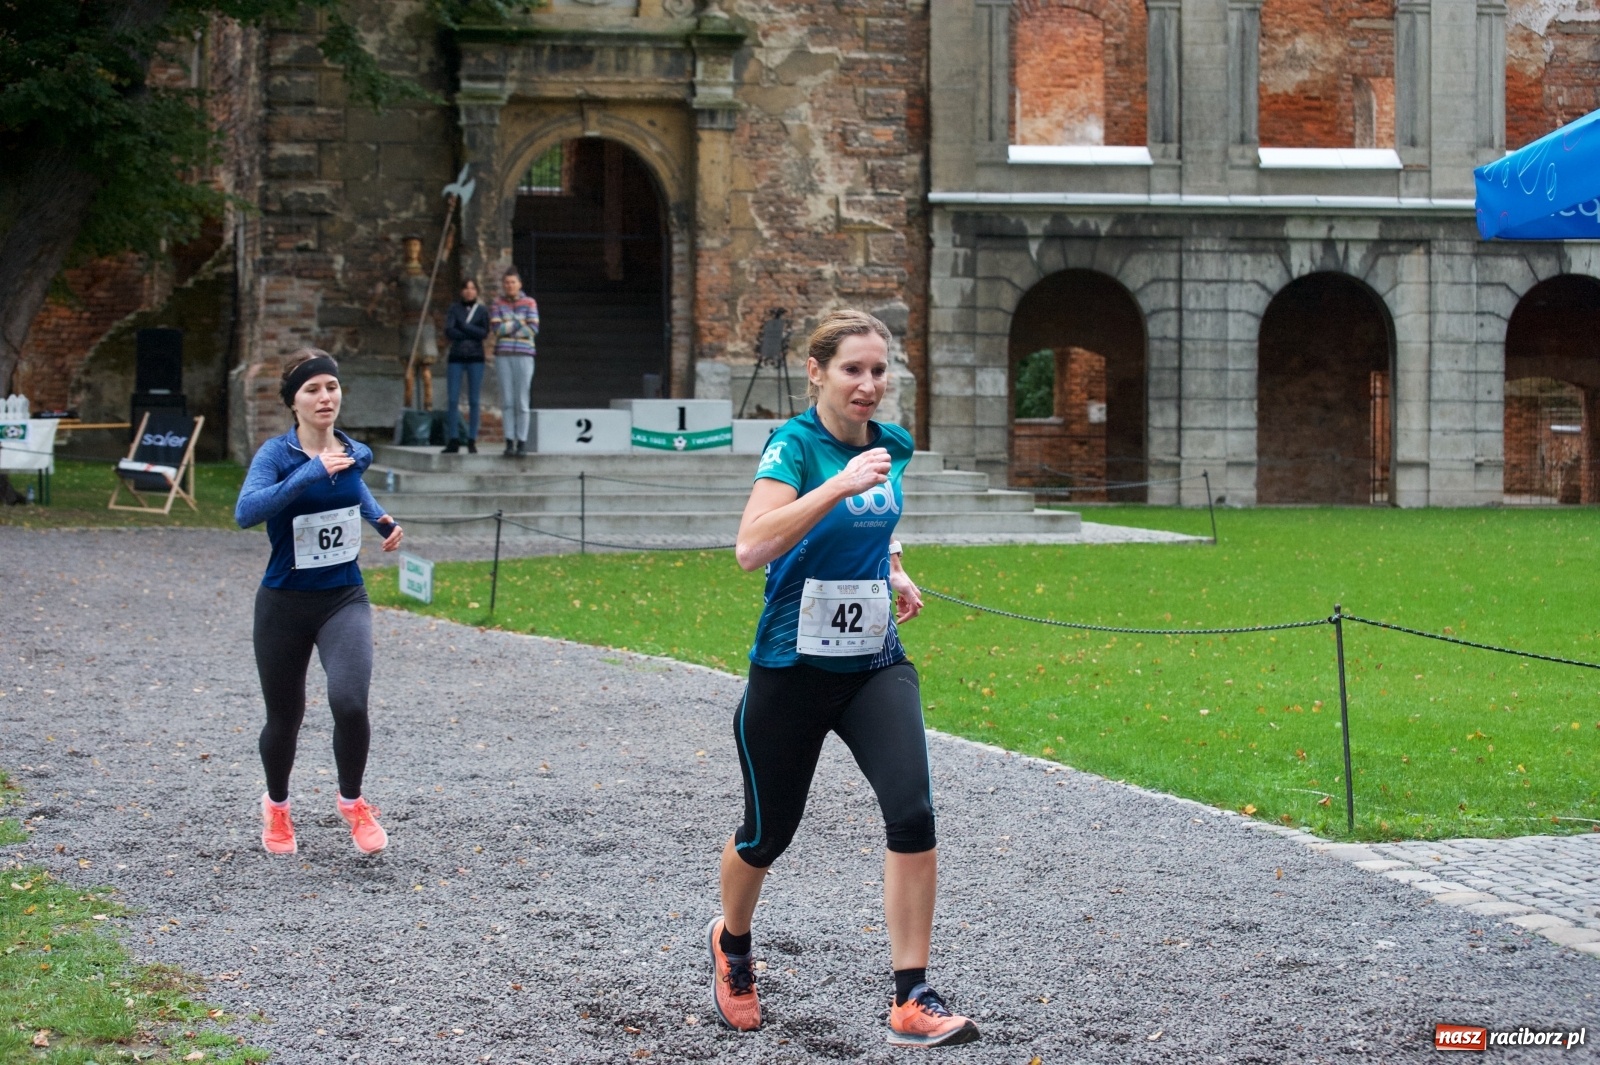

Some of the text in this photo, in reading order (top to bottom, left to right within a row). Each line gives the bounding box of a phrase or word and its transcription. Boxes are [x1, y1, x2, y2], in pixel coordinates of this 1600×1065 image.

[575, 418, 593, 443] 2
[677, 406, 687, 431] 1
[852, 519, 888, 528] RACIBÓRZ
[318, 525, 344, 551] 62
[831, 602, 863, 634] 42
